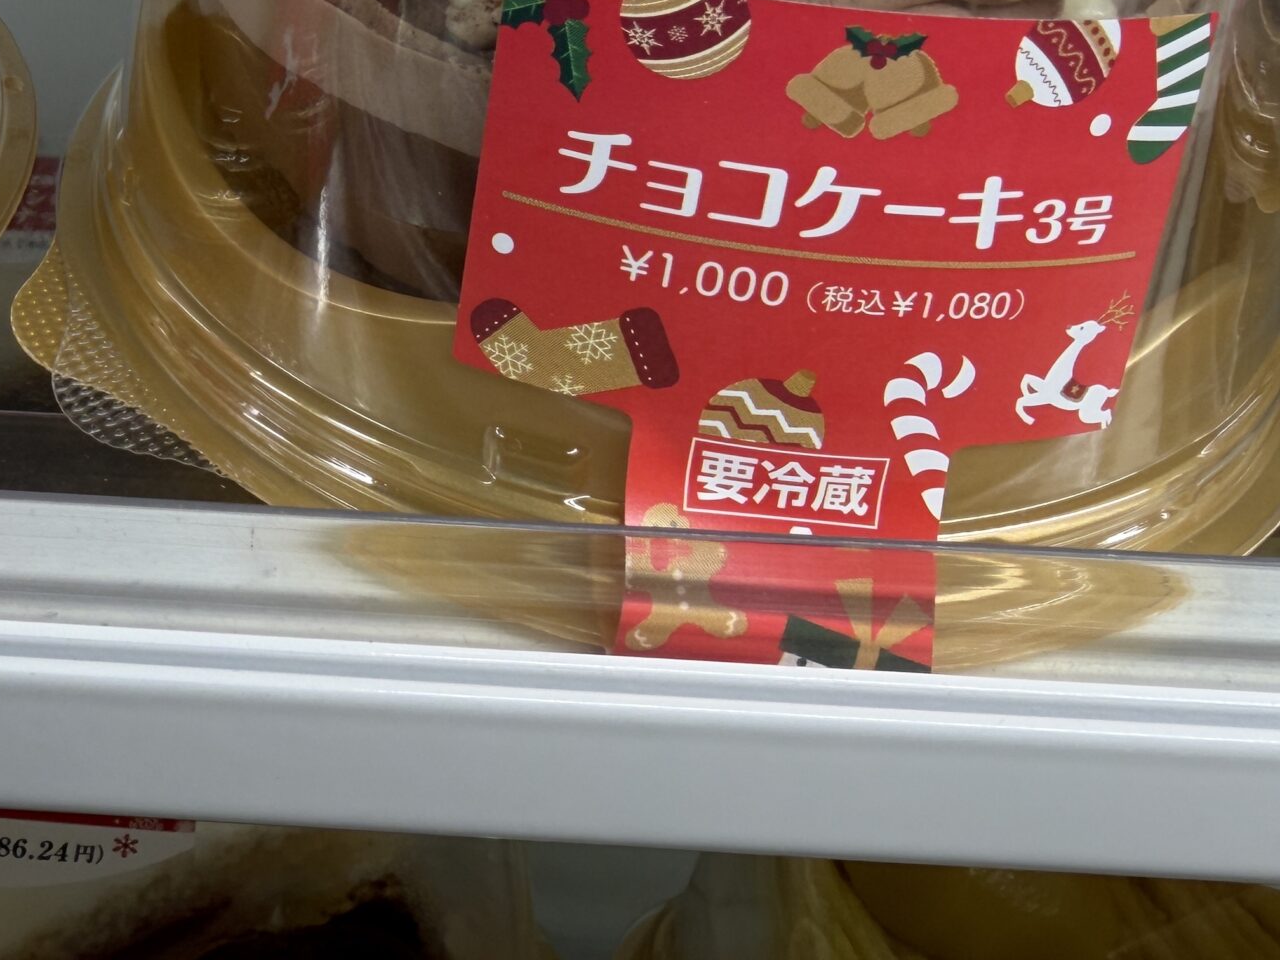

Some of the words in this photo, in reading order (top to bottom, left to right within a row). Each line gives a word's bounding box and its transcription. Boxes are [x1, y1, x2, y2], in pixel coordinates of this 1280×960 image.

[619, 244, 791, 308] ¥1,000
[696, 450, 877, 517] 要冷蔵
